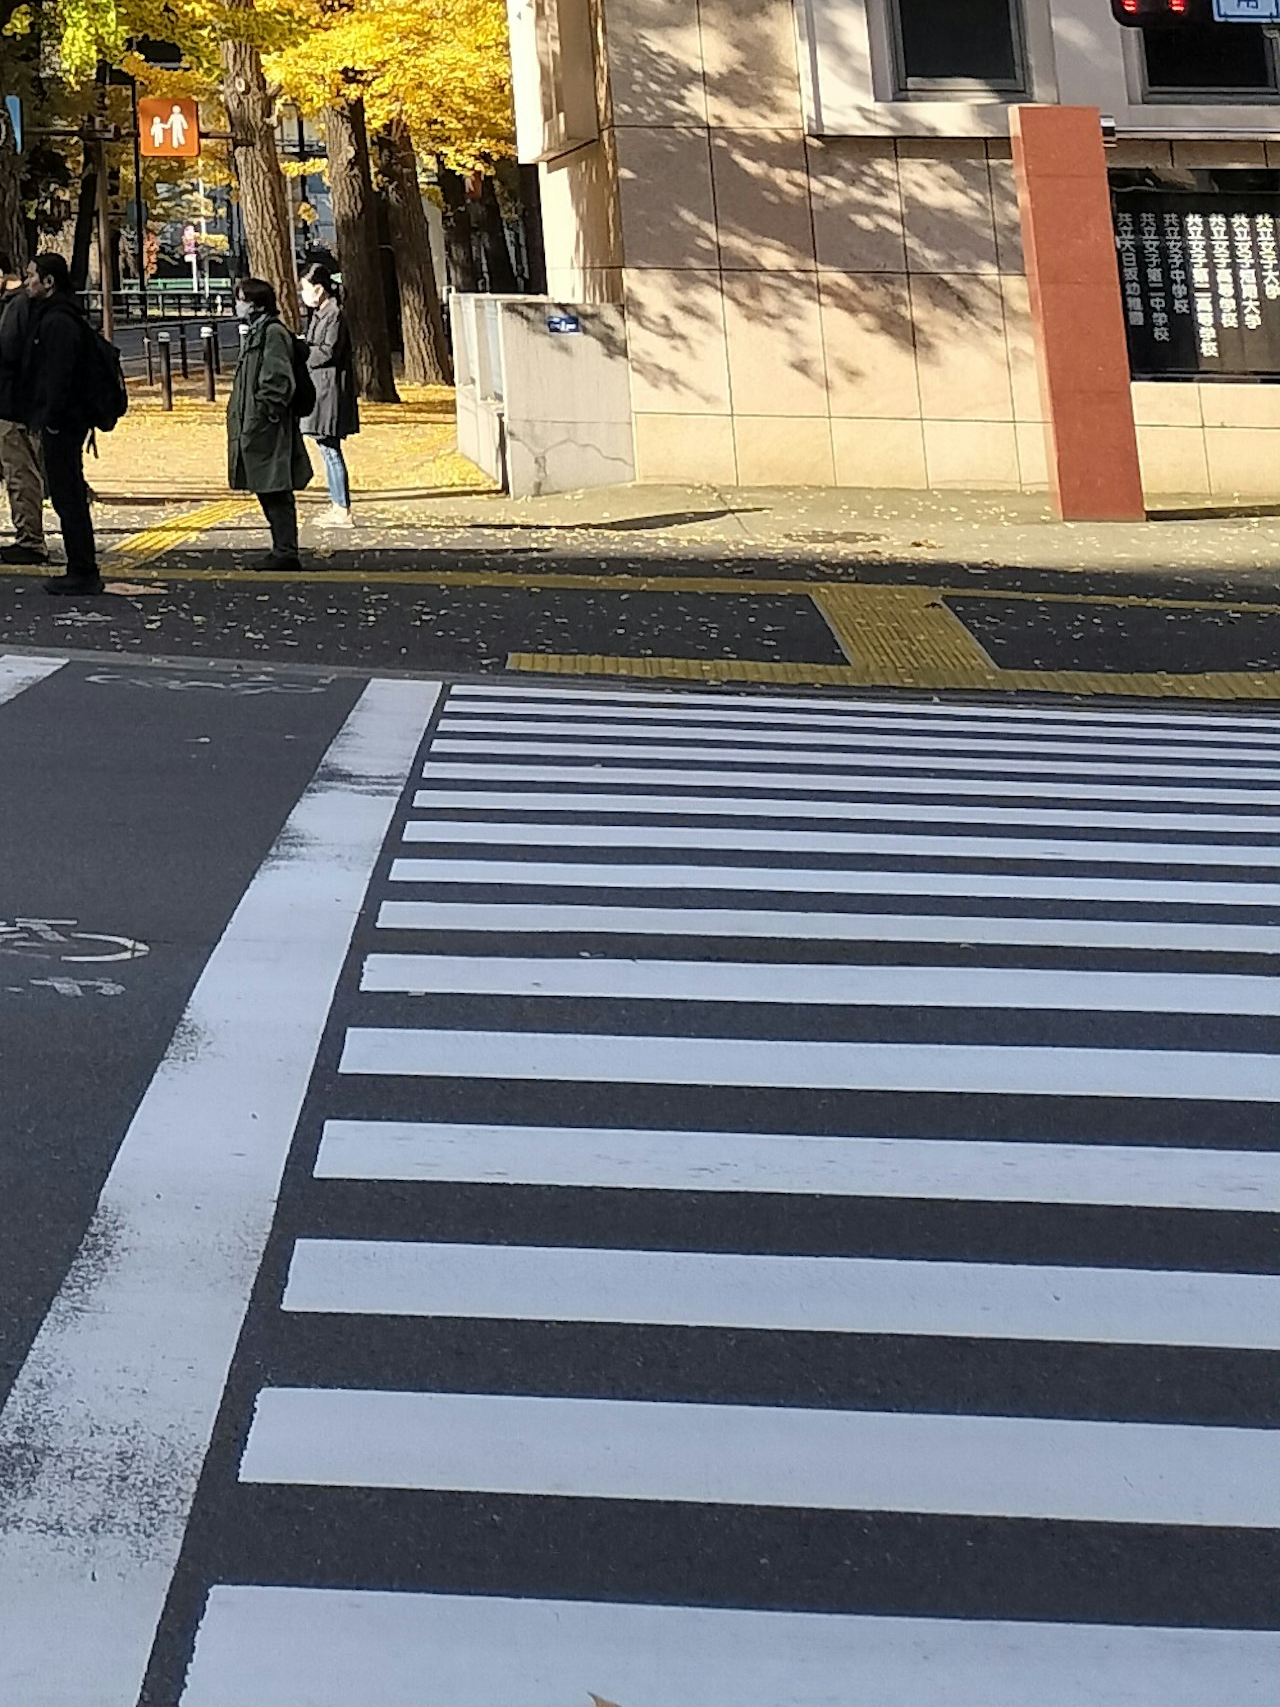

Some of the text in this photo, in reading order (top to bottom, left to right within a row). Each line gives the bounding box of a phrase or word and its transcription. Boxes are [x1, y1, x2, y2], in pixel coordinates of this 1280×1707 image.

[1163, 212, 1190, 315] 共立女子中学校
[1255, 212, 1280, 300] 共立女子大学
